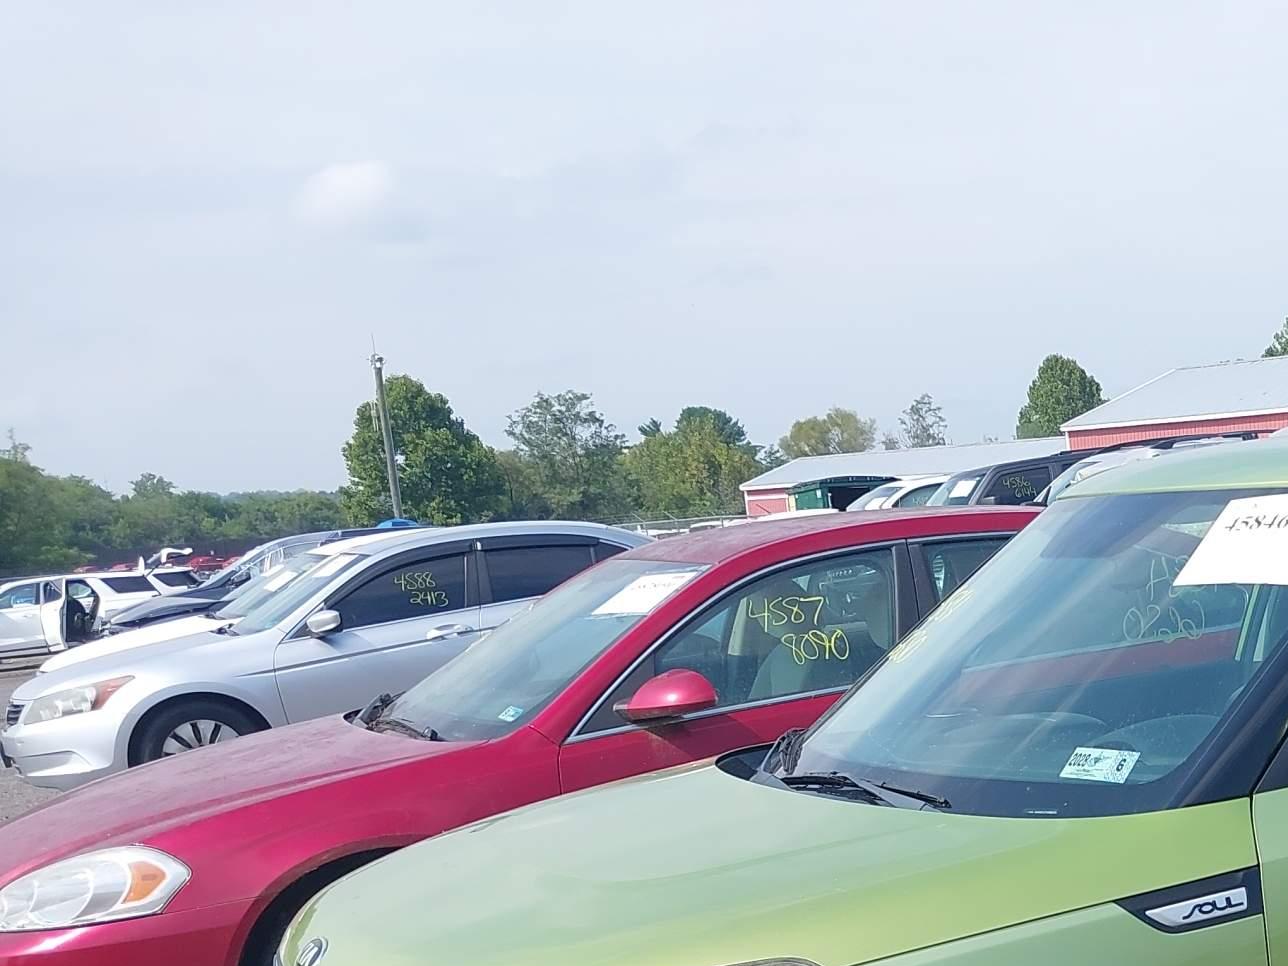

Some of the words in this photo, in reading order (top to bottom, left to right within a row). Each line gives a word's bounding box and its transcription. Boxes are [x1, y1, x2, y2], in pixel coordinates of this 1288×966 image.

[394, 572, 435, 591] 4588
[410, 591, 448, 607] 2413
[748, 596, 824, 632] 4587
[781, 629, 849, 665] 8090
[1182, 896, 1244, 920] SOUL
